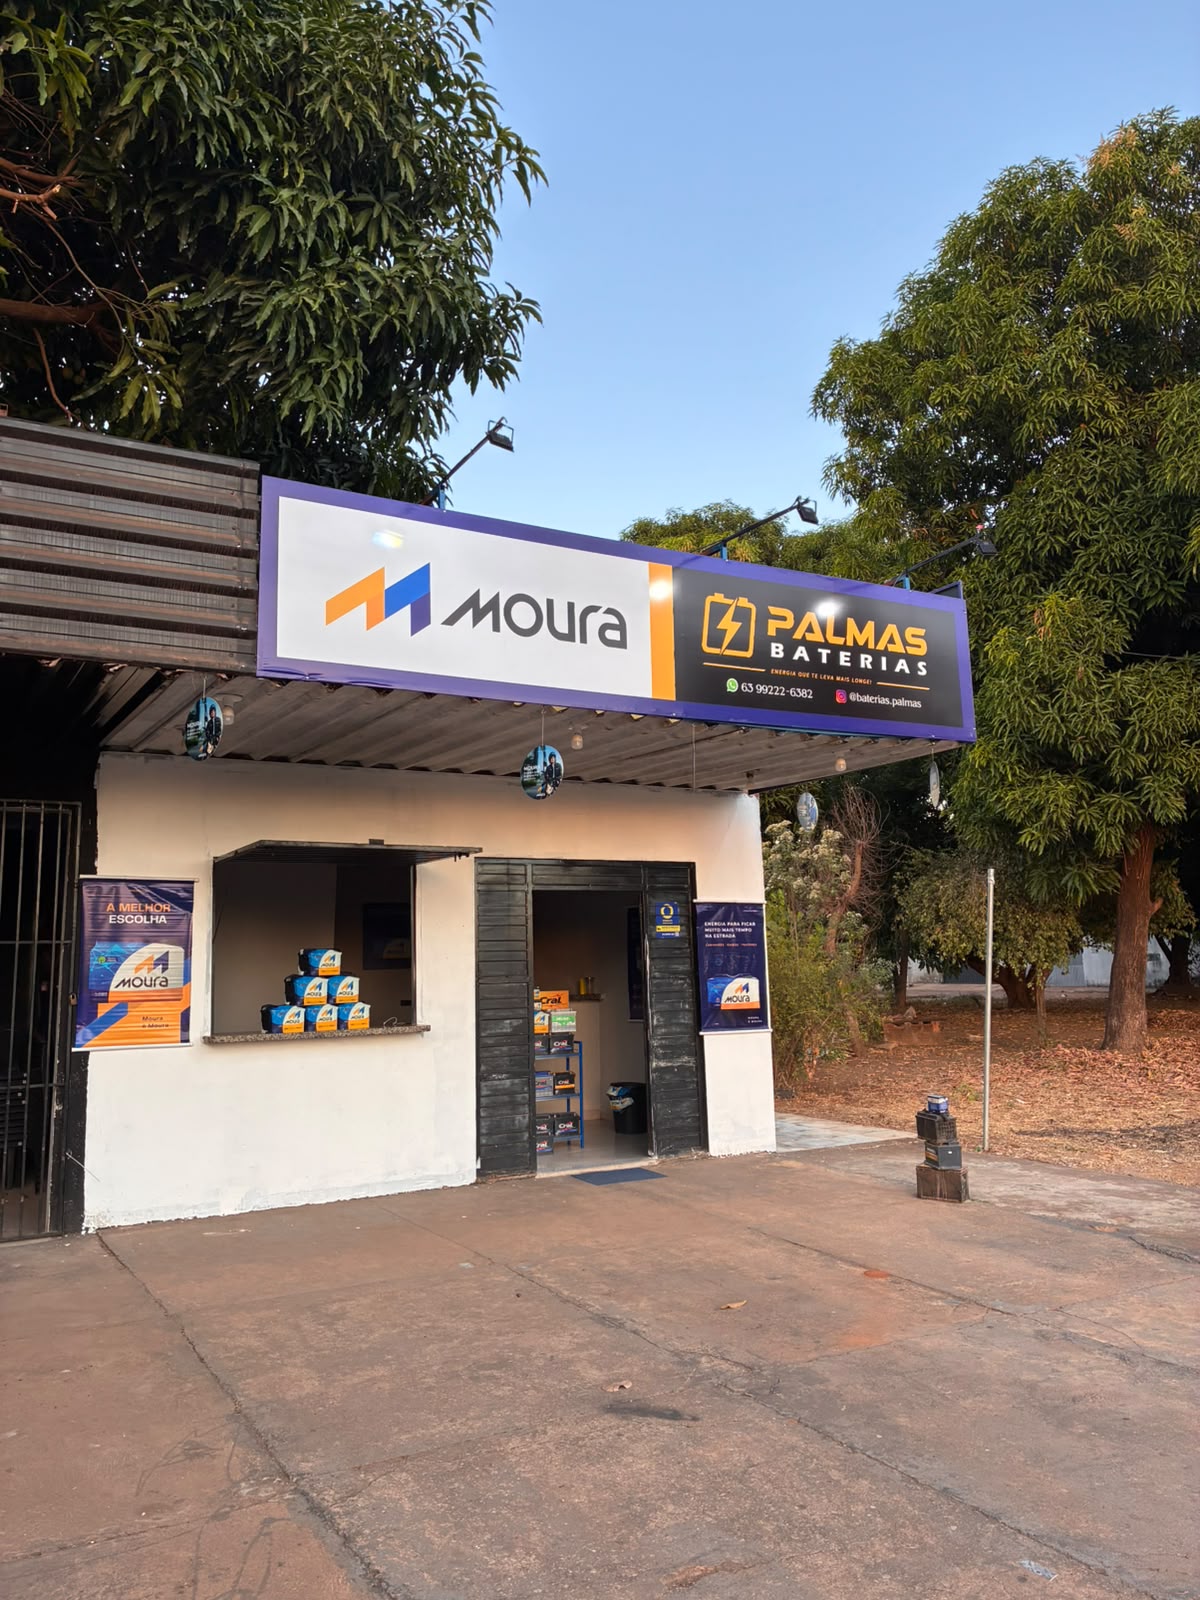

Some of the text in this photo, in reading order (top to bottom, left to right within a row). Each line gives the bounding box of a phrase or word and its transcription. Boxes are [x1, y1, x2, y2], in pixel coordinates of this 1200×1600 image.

[767, 605, 928, 657] PALMAS
[770, 642, 928, 676] BATERIAS
[771, 668, 796, 676] ENERGIA
[741, 682, 814, 699] 63 99222-6382
[849, 691, 922, 709] @baterias.palmas
[106, 903, 171, 912] A MELHOR
[109, 914, 167, 924] ESCOLHA
